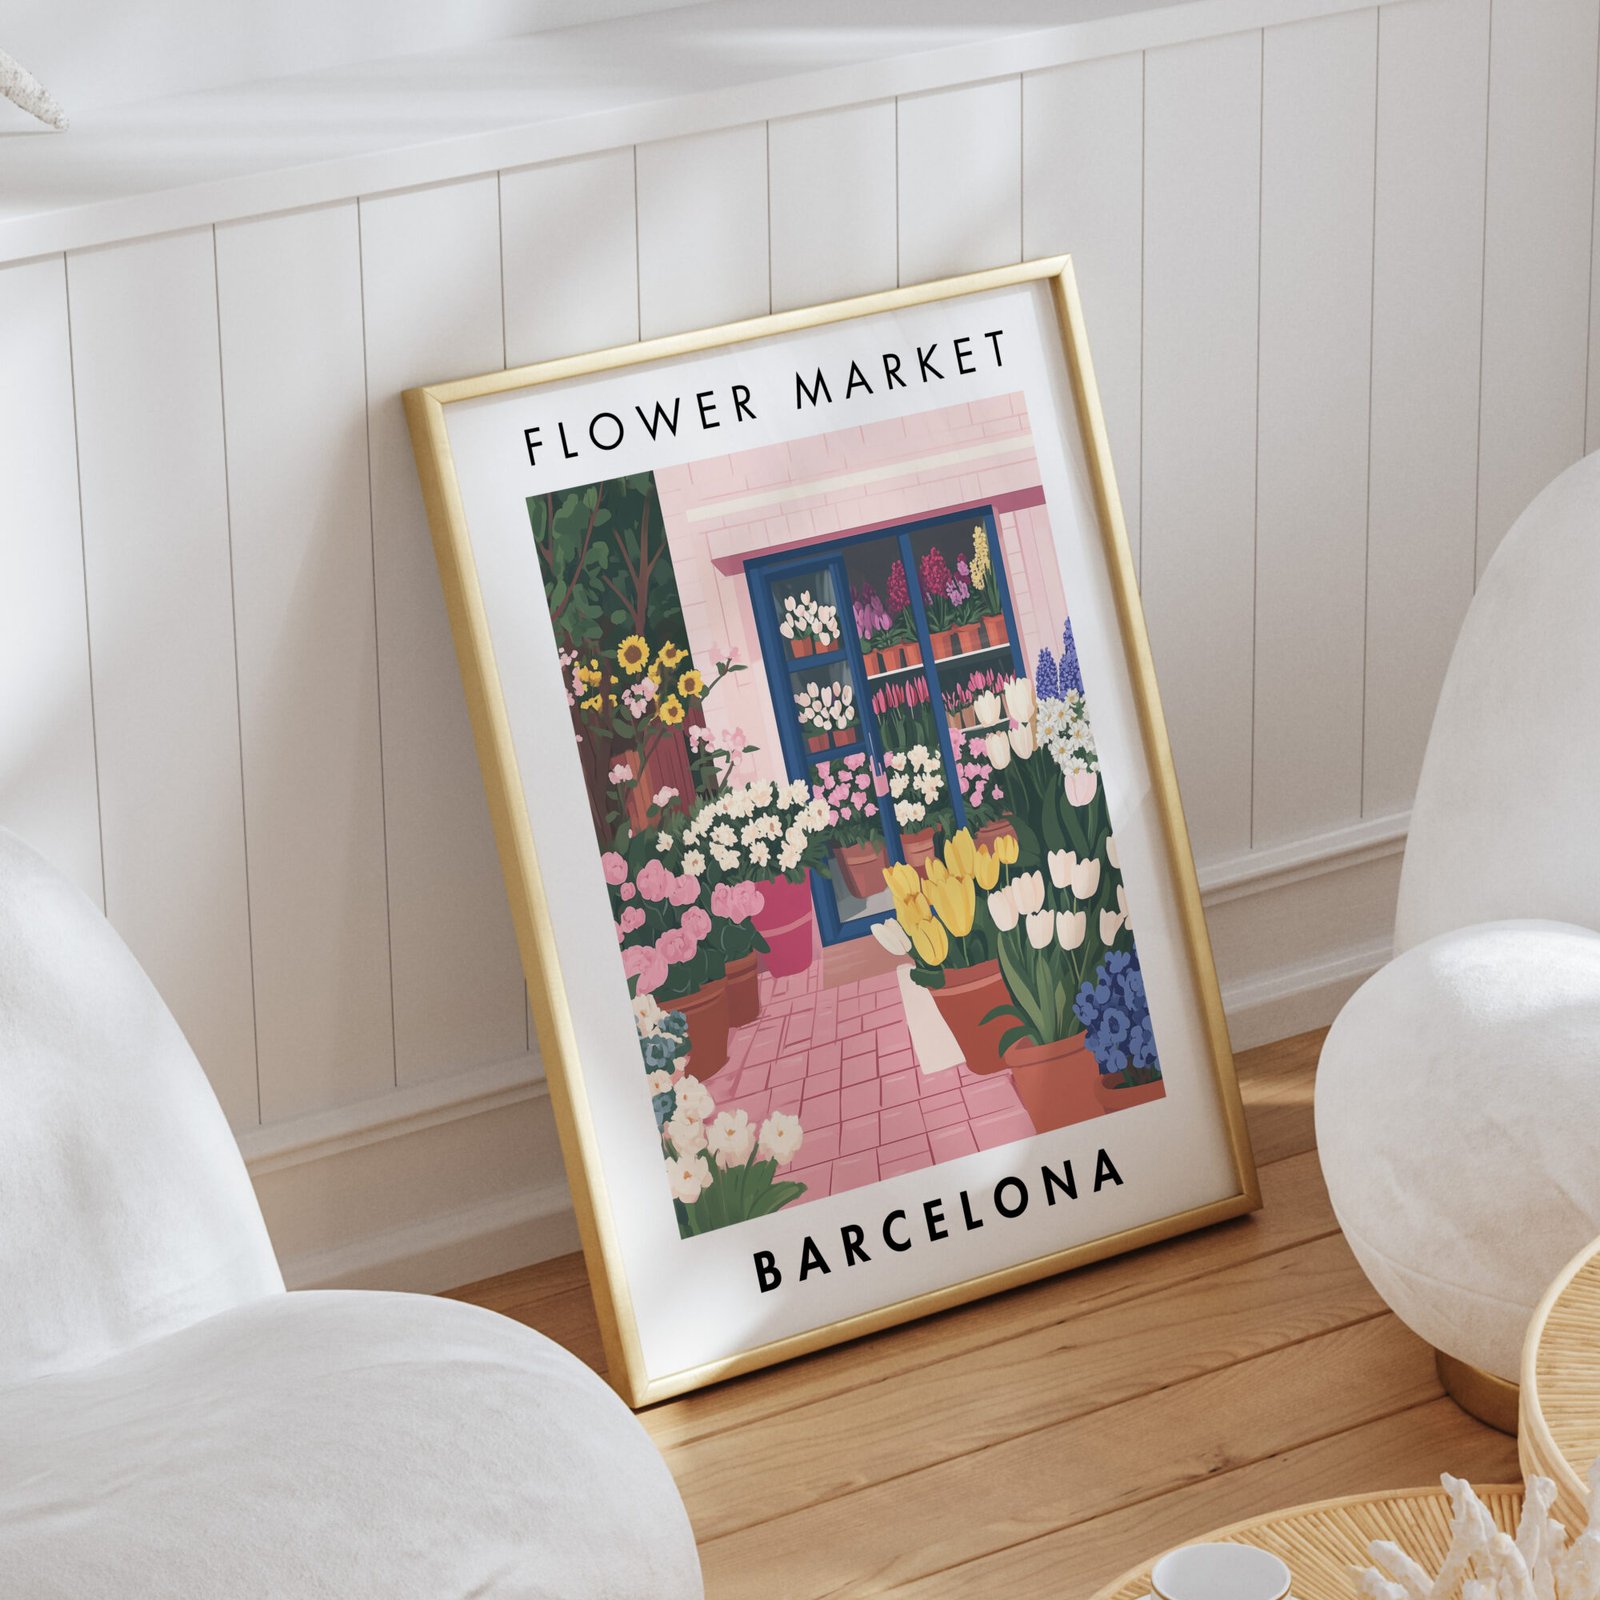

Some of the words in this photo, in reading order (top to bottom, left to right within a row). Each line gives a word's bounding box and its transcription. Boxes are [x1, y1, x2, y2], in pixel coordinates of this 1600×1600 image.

[523, 384, 757, 466] FLOWER
[795, 329, 1008, 410] MARKET
[753, 1148, 1124, 1294] BARCELONA
